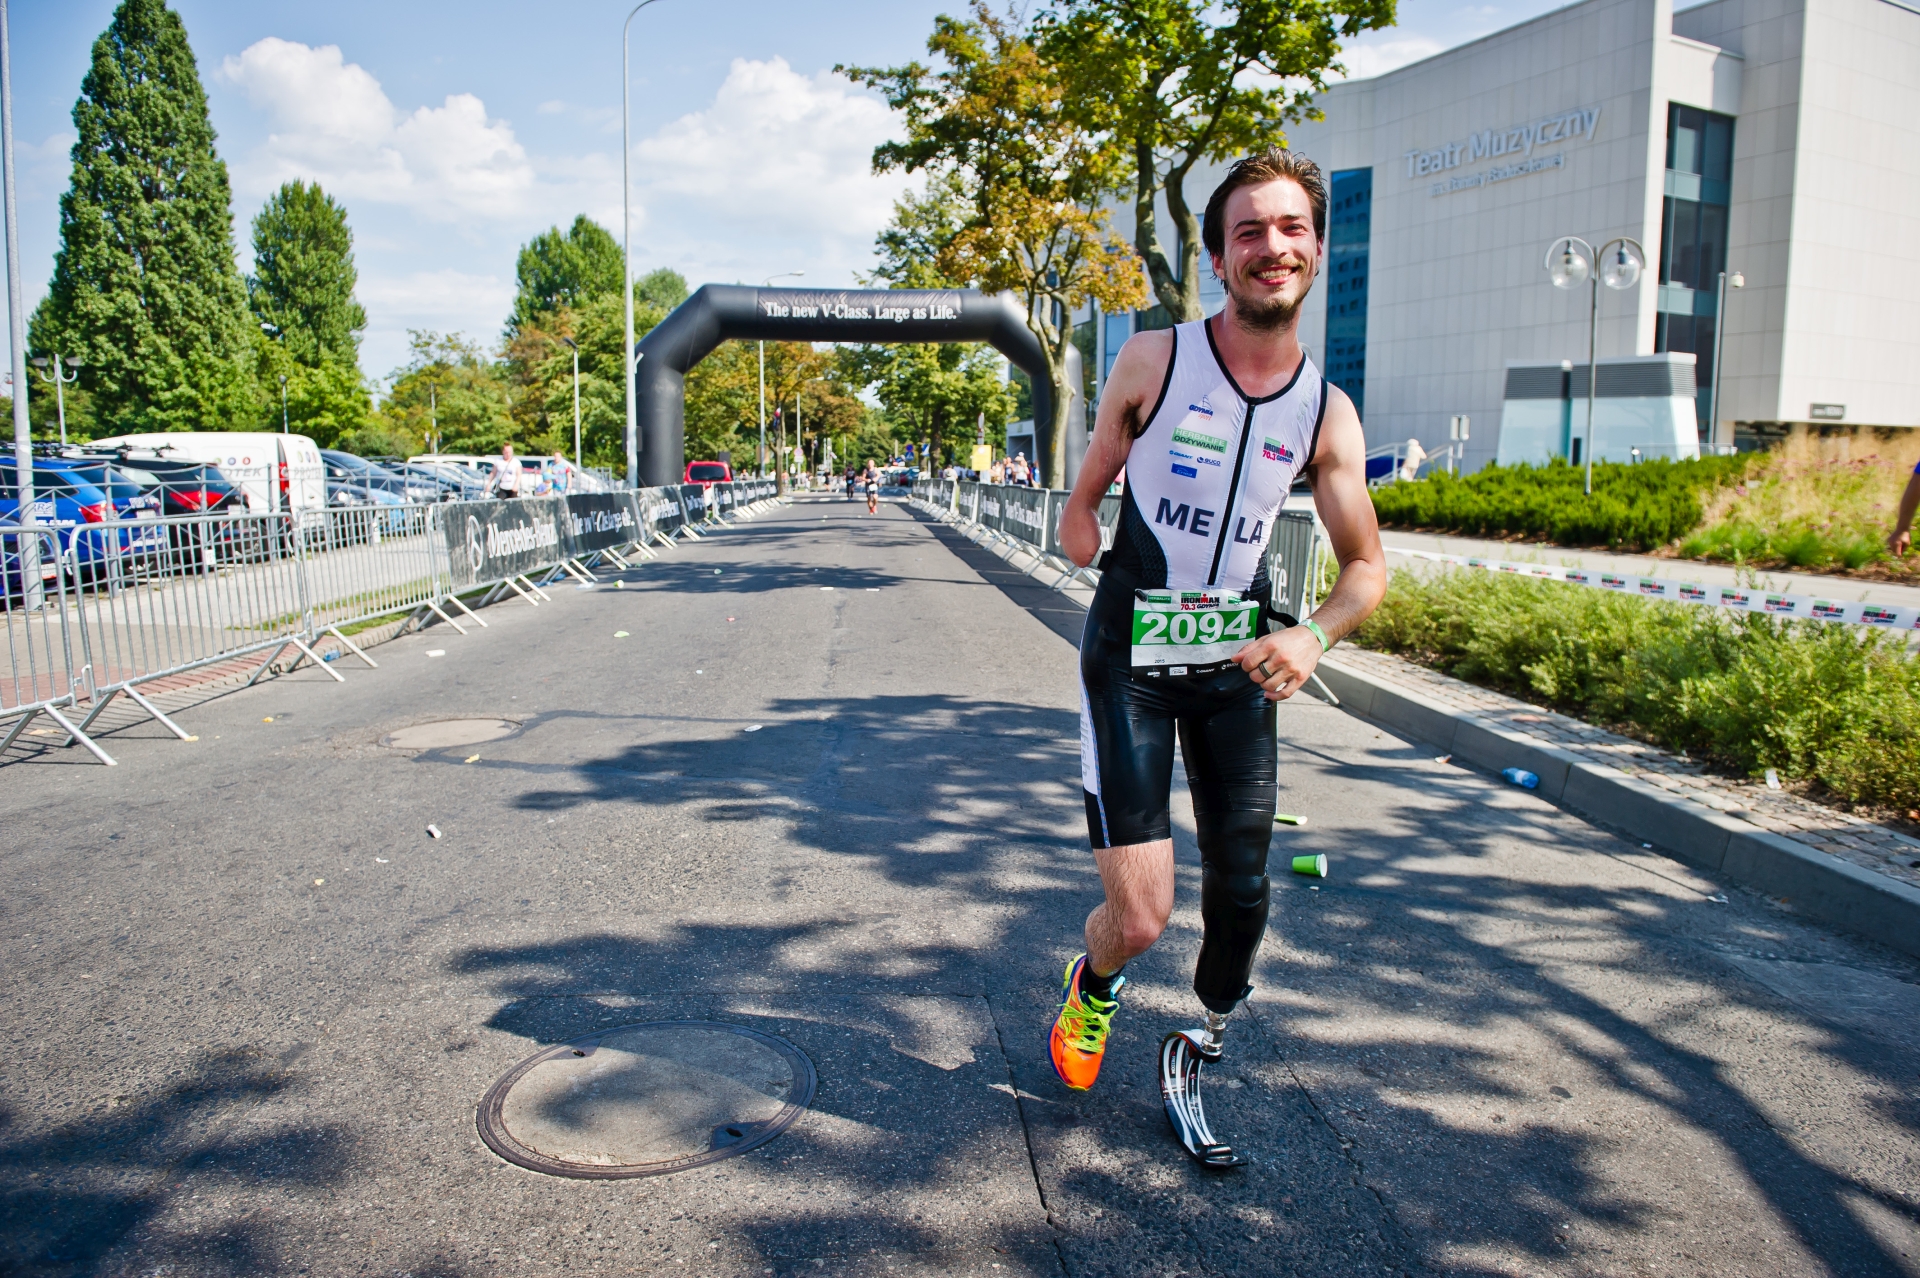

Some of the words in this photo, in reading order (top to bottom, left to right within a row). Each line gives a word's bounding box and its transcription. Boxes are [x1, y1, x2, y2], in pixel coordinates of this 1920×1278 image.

[1403, 141, 1465, 179] Teatr
[1467, 107, 1602, 163] Muzyczny
[766, 302, 790, 318] The
[792, 306, 819, 318] new
[822, 303, 872, 320] V-Class.
[875, 304, 911, 323] Large
[912, 308, 928, 320] as
[929, 304, 957, 320] Life.
[1188, 404, 1214, 416] GDYNIA
[1174, 434, 1225, 453] ODŻYWIANIE
[1175, 428, 1225, 446] HERBALIFE
[1262, 449, 1276, 461] 70.3
[1263, 441, 1294, 459] IRONMAN
[1154, 496, 1215, 538] ME
[1233, 516, 1264, 544] LA
[1181, 595, 1220, 604] IRONMAN
[1181, 603, 1197, 611] 70.3
[1139, 609, 1252, 645] 2094
